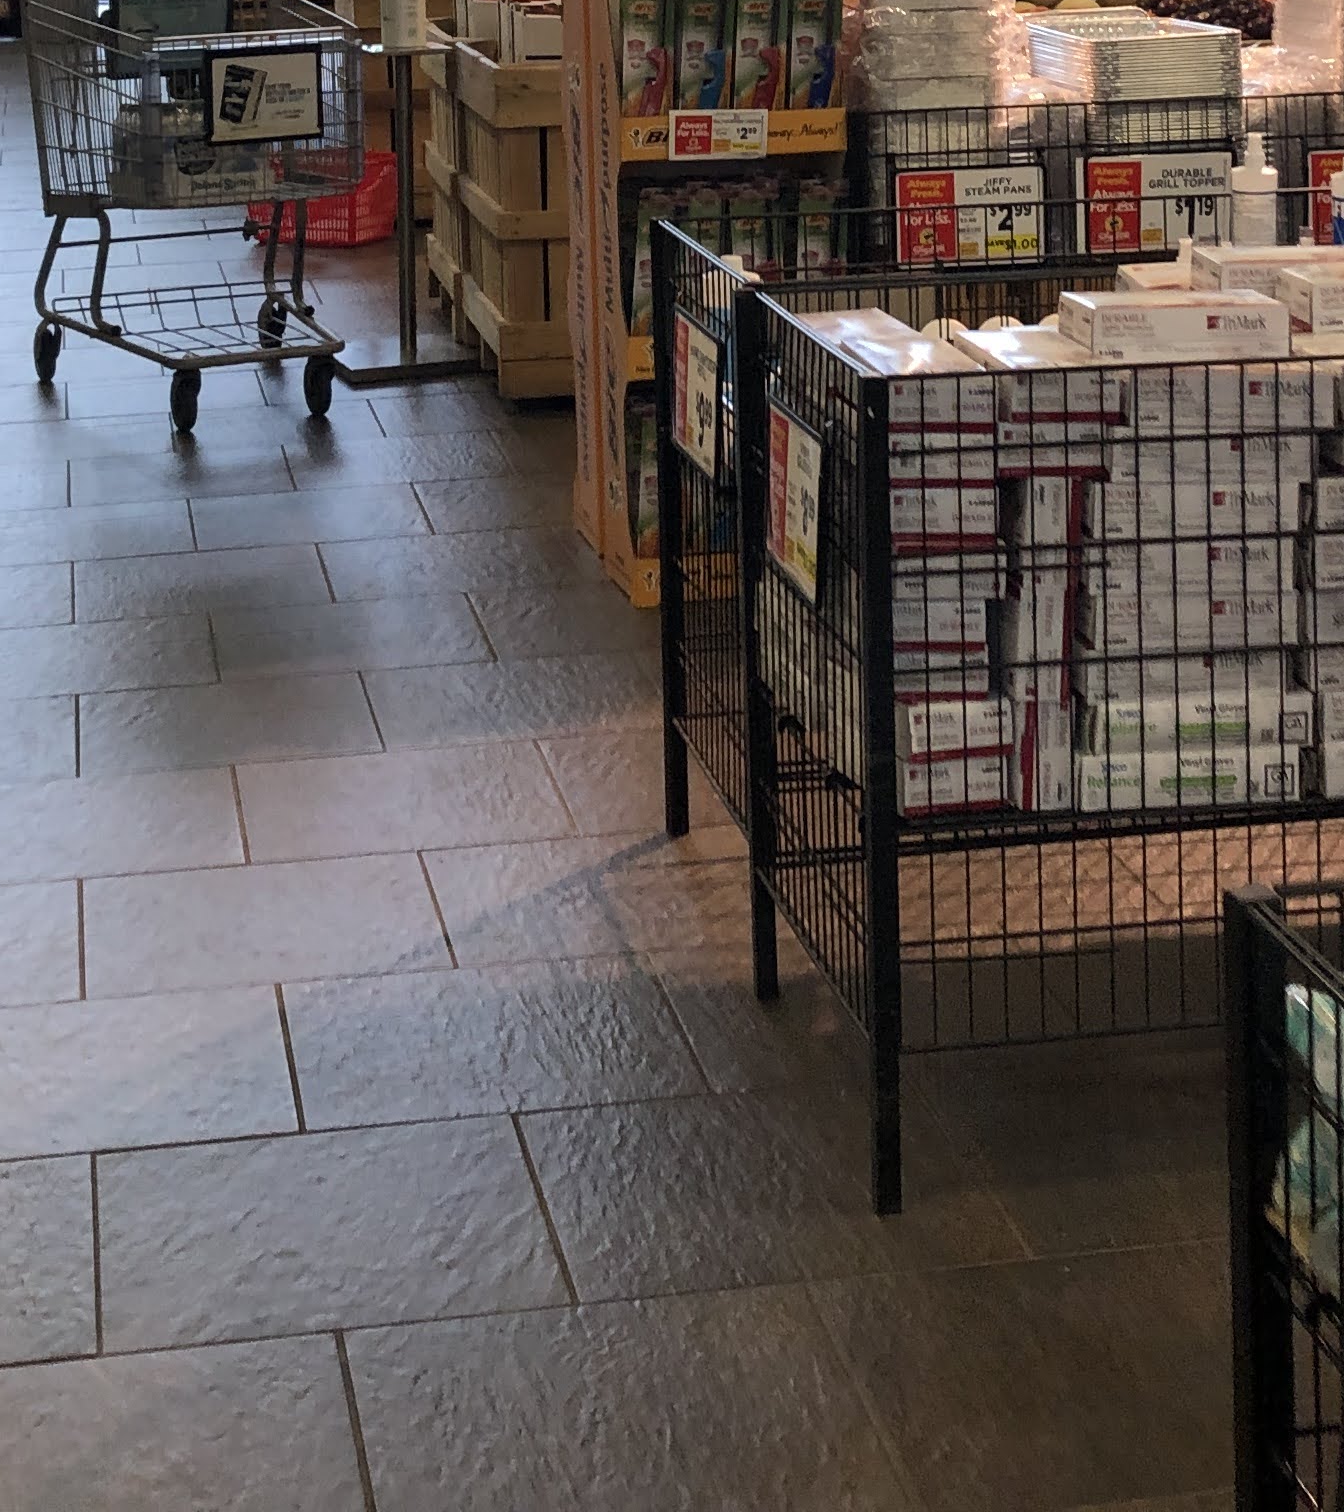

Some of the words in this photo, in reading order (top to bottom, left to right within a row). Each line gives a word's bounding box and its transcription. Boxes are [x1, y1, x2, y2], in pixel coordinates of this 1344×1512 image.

[1161, 167, 1213, 179] DURABLE
[907, 178, 946, 189] Always
[983, 177, 1012, 187] JIFFY
[1148, 179, 1180, 189] GRILL
[1183, 176, 1225, 189] TOPPER
[965, 187, 1000, 197] STEAM
[1004, 185, 1032, 195] PANS
[925, 213, 951, 226] Lss.
[1222, 312, 1267, 331] TriMark
